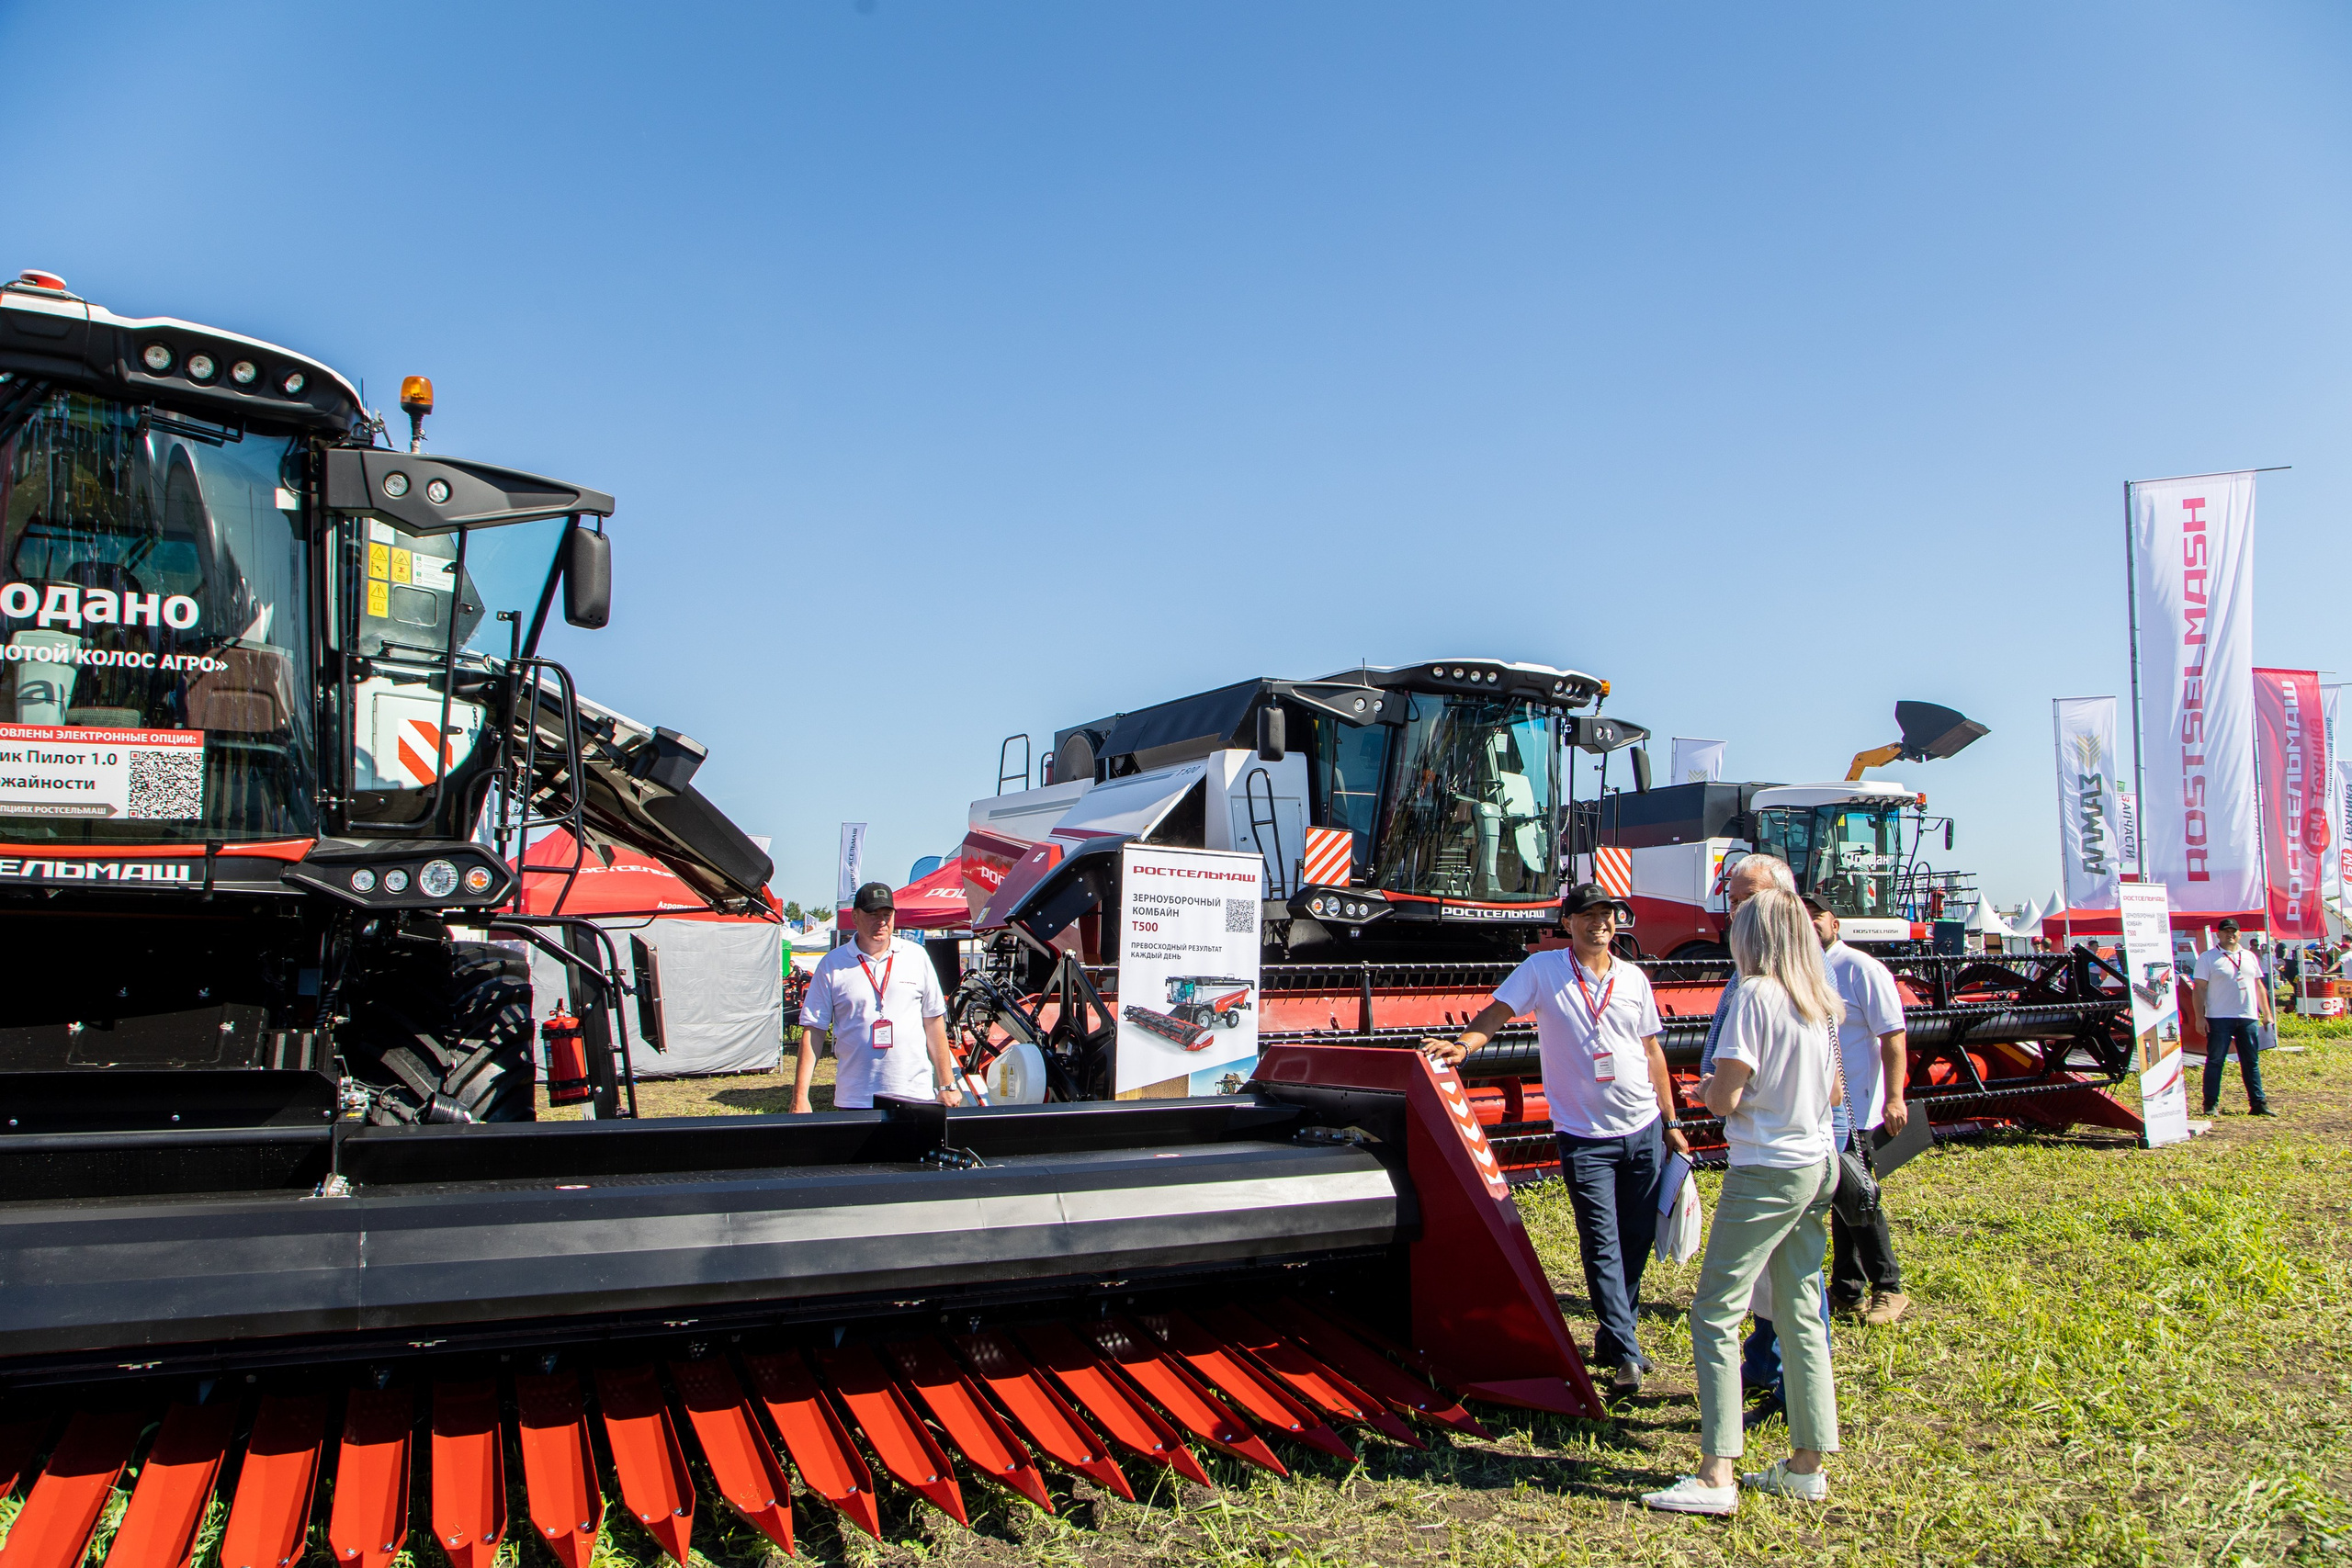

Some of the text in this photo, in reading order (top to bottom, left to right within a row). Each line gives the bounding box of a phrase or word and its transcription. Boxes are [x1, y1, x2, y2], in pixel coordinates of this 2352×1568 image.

[0, 582, 199, 629] одано
[75, 649, 156, 668] КОЛОС
[160, 654, 229, 672] АГРО»
[2183, 497, 2210, 882] ROSTSELMASH
[0, 728, 197, 744] ОВЛЕНЫ ЭЛЕКТРОННЫЕ ОПЦИИ:
[28, 750, 85, 764] Пилот
[92, 752, 118, 765] 1.0
[0, 775, 96, 790] жайности
[2281, 681, 2302, 921] РОСТСЕЛЬМАШ
[35, 806, 107, 815] РОСТСЕЛЬМАШ
[2078, 773, 2106, 874] АЛМАЗ
[2121, 795, 2135, 859] ЗАПЧАСТИ
[0, 859, 189, 882] ЕЛЬМАШ
[1133, 865, 1256, 883] РОСТСЕЛЬМАШ
[1132, 894, 1221, 907] ЗЕРНОУБОРОЧНЫЙ
[1132, 907, 1180, 917] КОМБАЙН
[1442, 907, 1545, 919] РОСТСЕЛЬМАШ
[1132, 921, 1159, 931] T500
[1131, 942, 1223, 953] ПРЕВОСХОДНЫЙ РЕЗУЛЬТАТ
[1163, 953, 1182, 961] ДЕНЬ
